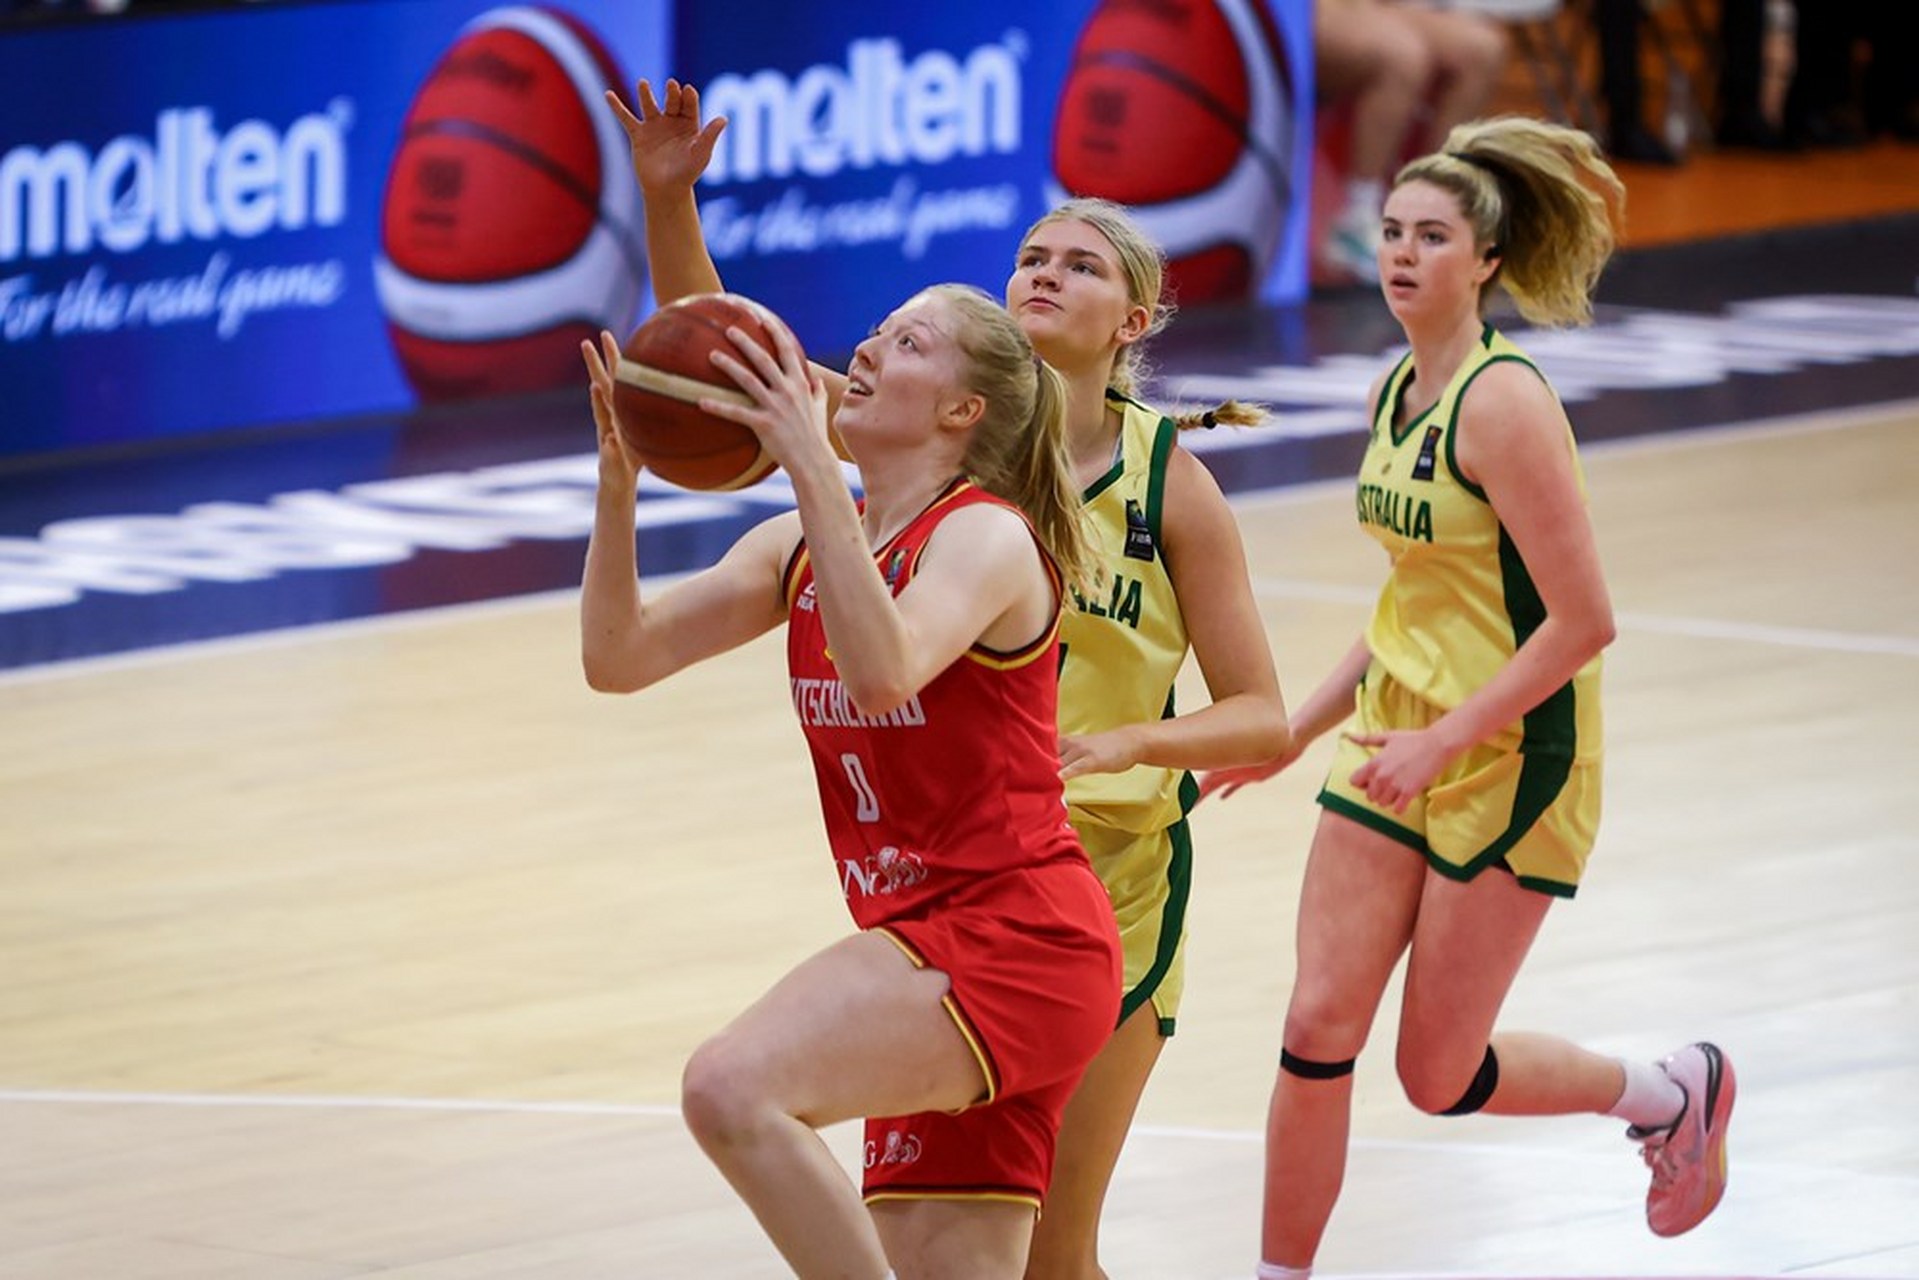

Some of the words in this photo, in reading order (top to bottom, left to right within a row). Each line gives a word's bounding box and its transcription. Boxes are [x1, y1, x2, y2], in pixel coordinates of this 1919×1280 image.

[700, 38, 1021, 186] molten
[0, 105, 346, 262] molten
[755, 188, 822, 253] the
[820, 175, 914, 246] real
[901, 183, 1019, 260] game
[52, 263, 129, 336] the
[124, 250, 231, 327] real
[215, 258, 344, 341] game
[841, 753, 880, 822] 0
